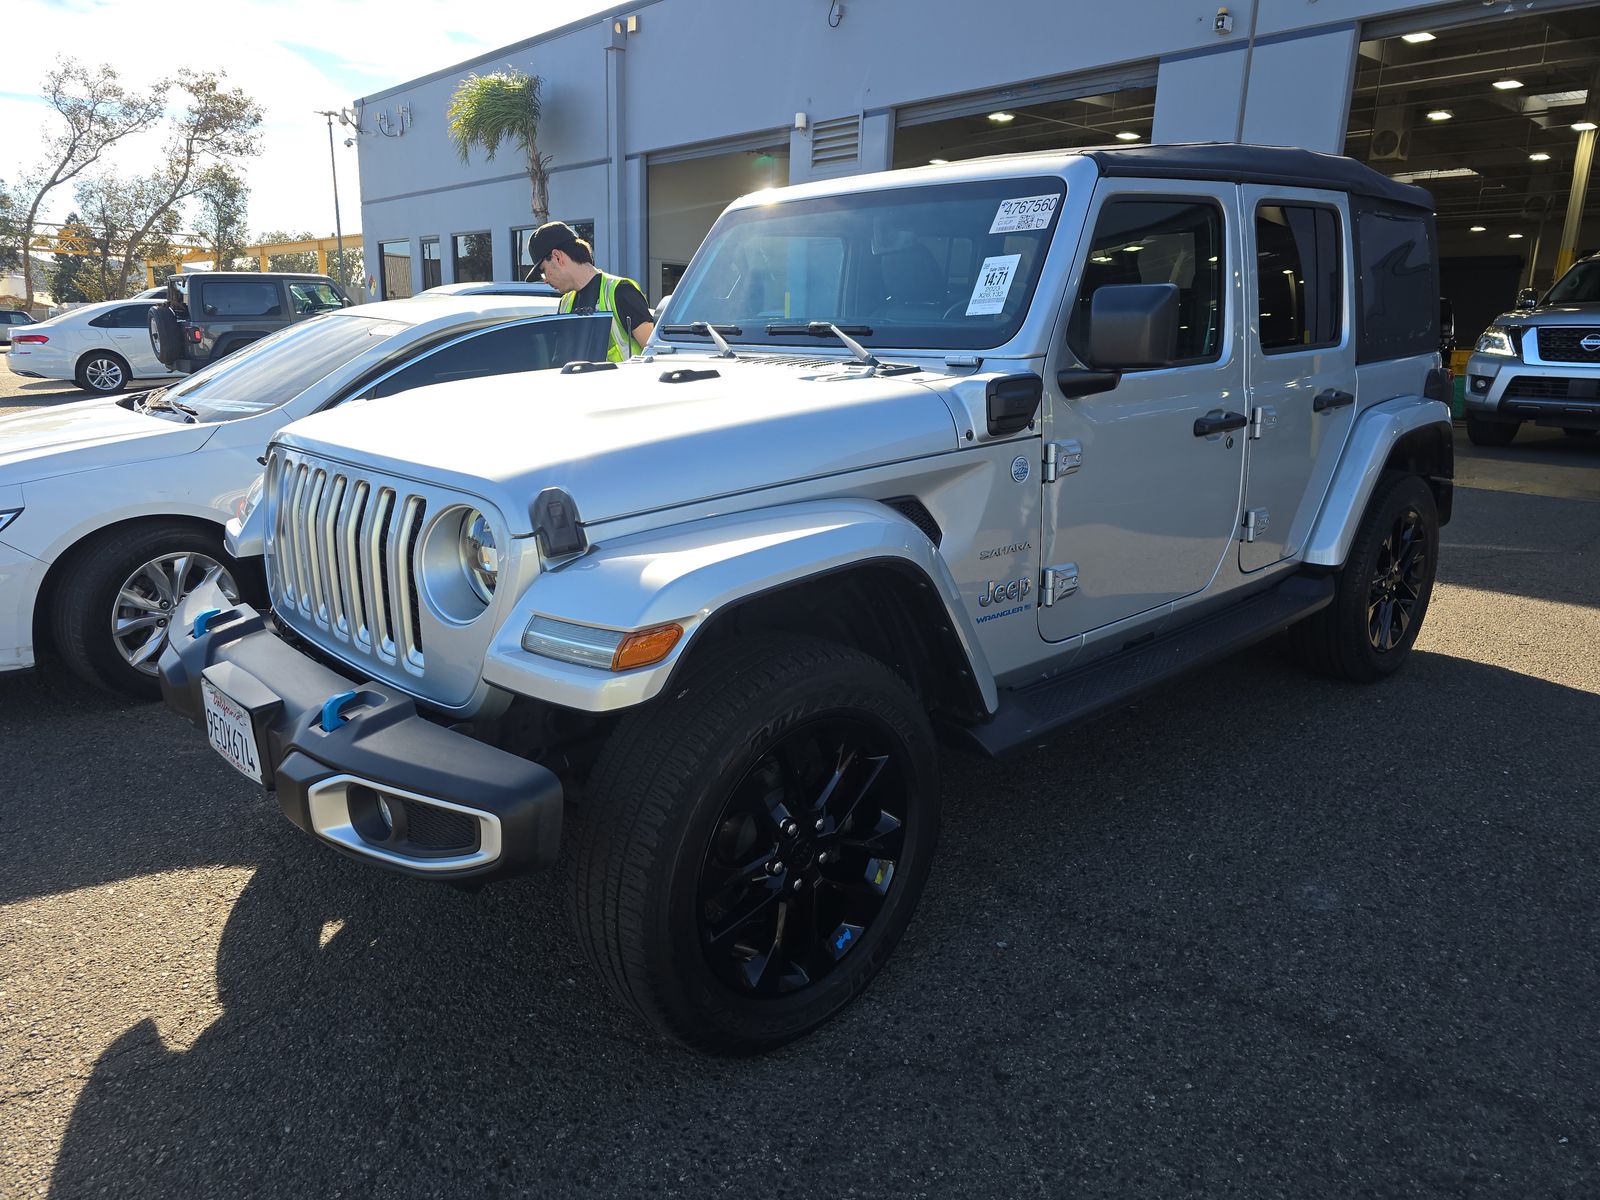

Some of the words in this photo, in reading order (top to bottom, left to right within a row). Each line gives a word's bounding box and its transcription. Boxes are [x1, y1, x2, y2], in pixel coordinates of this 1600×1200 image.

[1003, 198, 1058, 215] 4767560
[984, 271, 1009, 286] 14:71
[980, 541, 1032, 560] SAHARA
[978, 577, 1032, 607] Jeep
[976, 605, 1023, 624] WRANGLER
